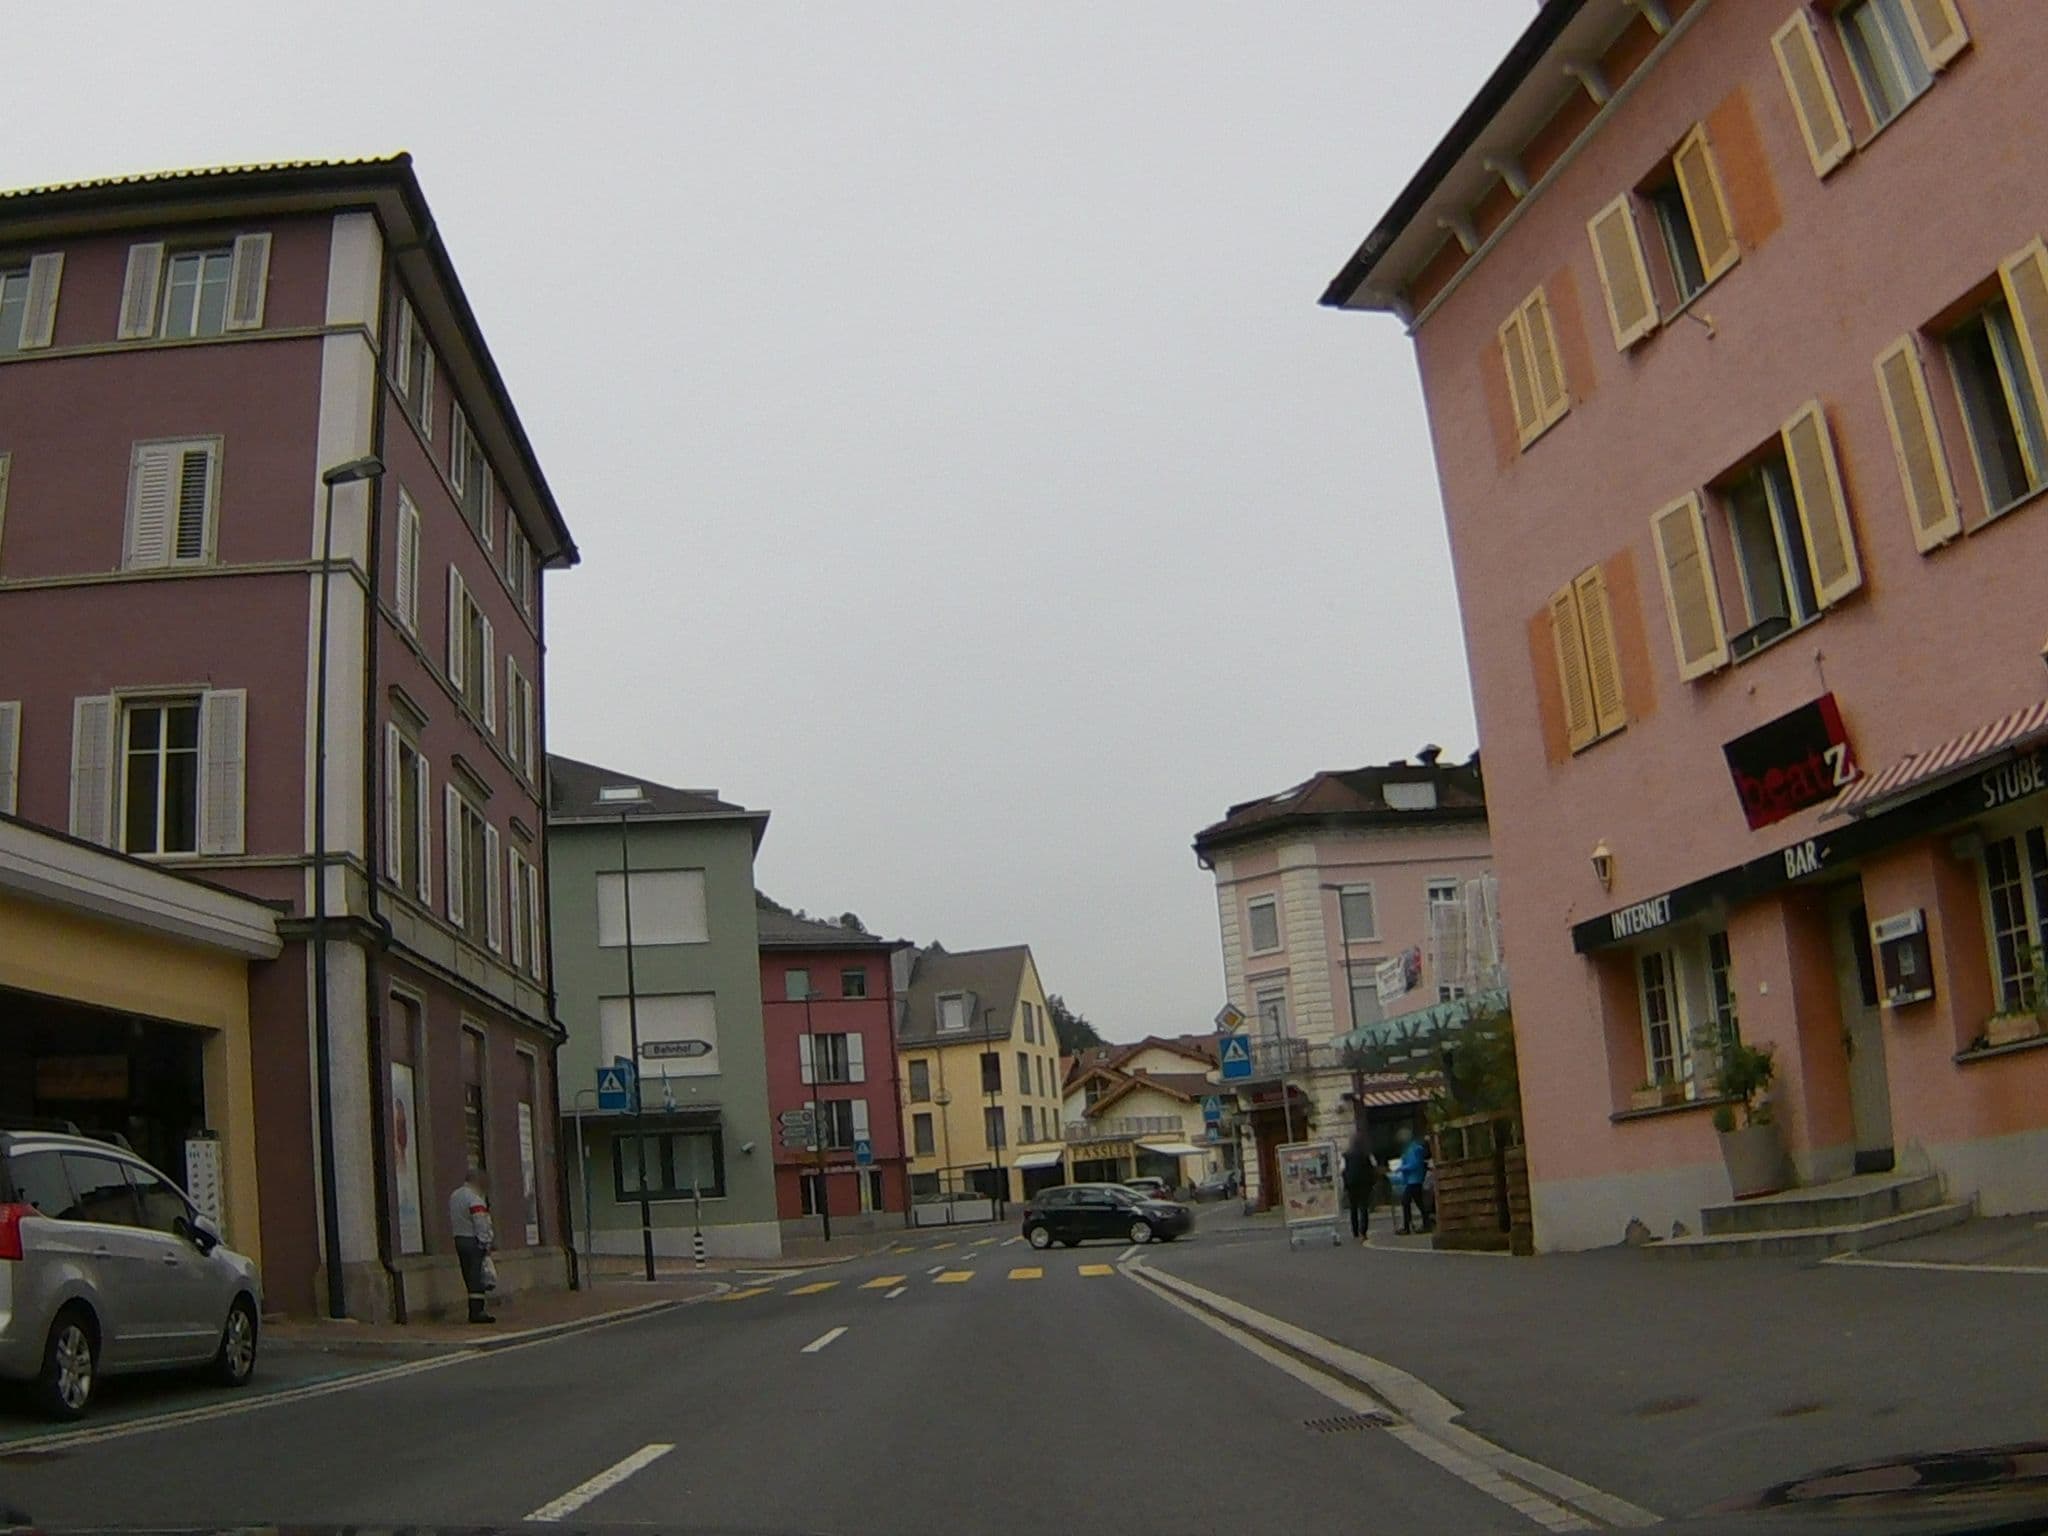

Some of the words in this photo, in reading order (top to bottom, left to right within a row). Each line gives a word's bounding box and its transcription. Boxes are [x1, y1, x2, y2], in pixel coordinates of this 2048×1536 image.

[1611, 895, 1672, 940] INTERNET
[1981, 756, 2045, 809] STUBE
[653, 1043, 692, 1055] Bahnhof
